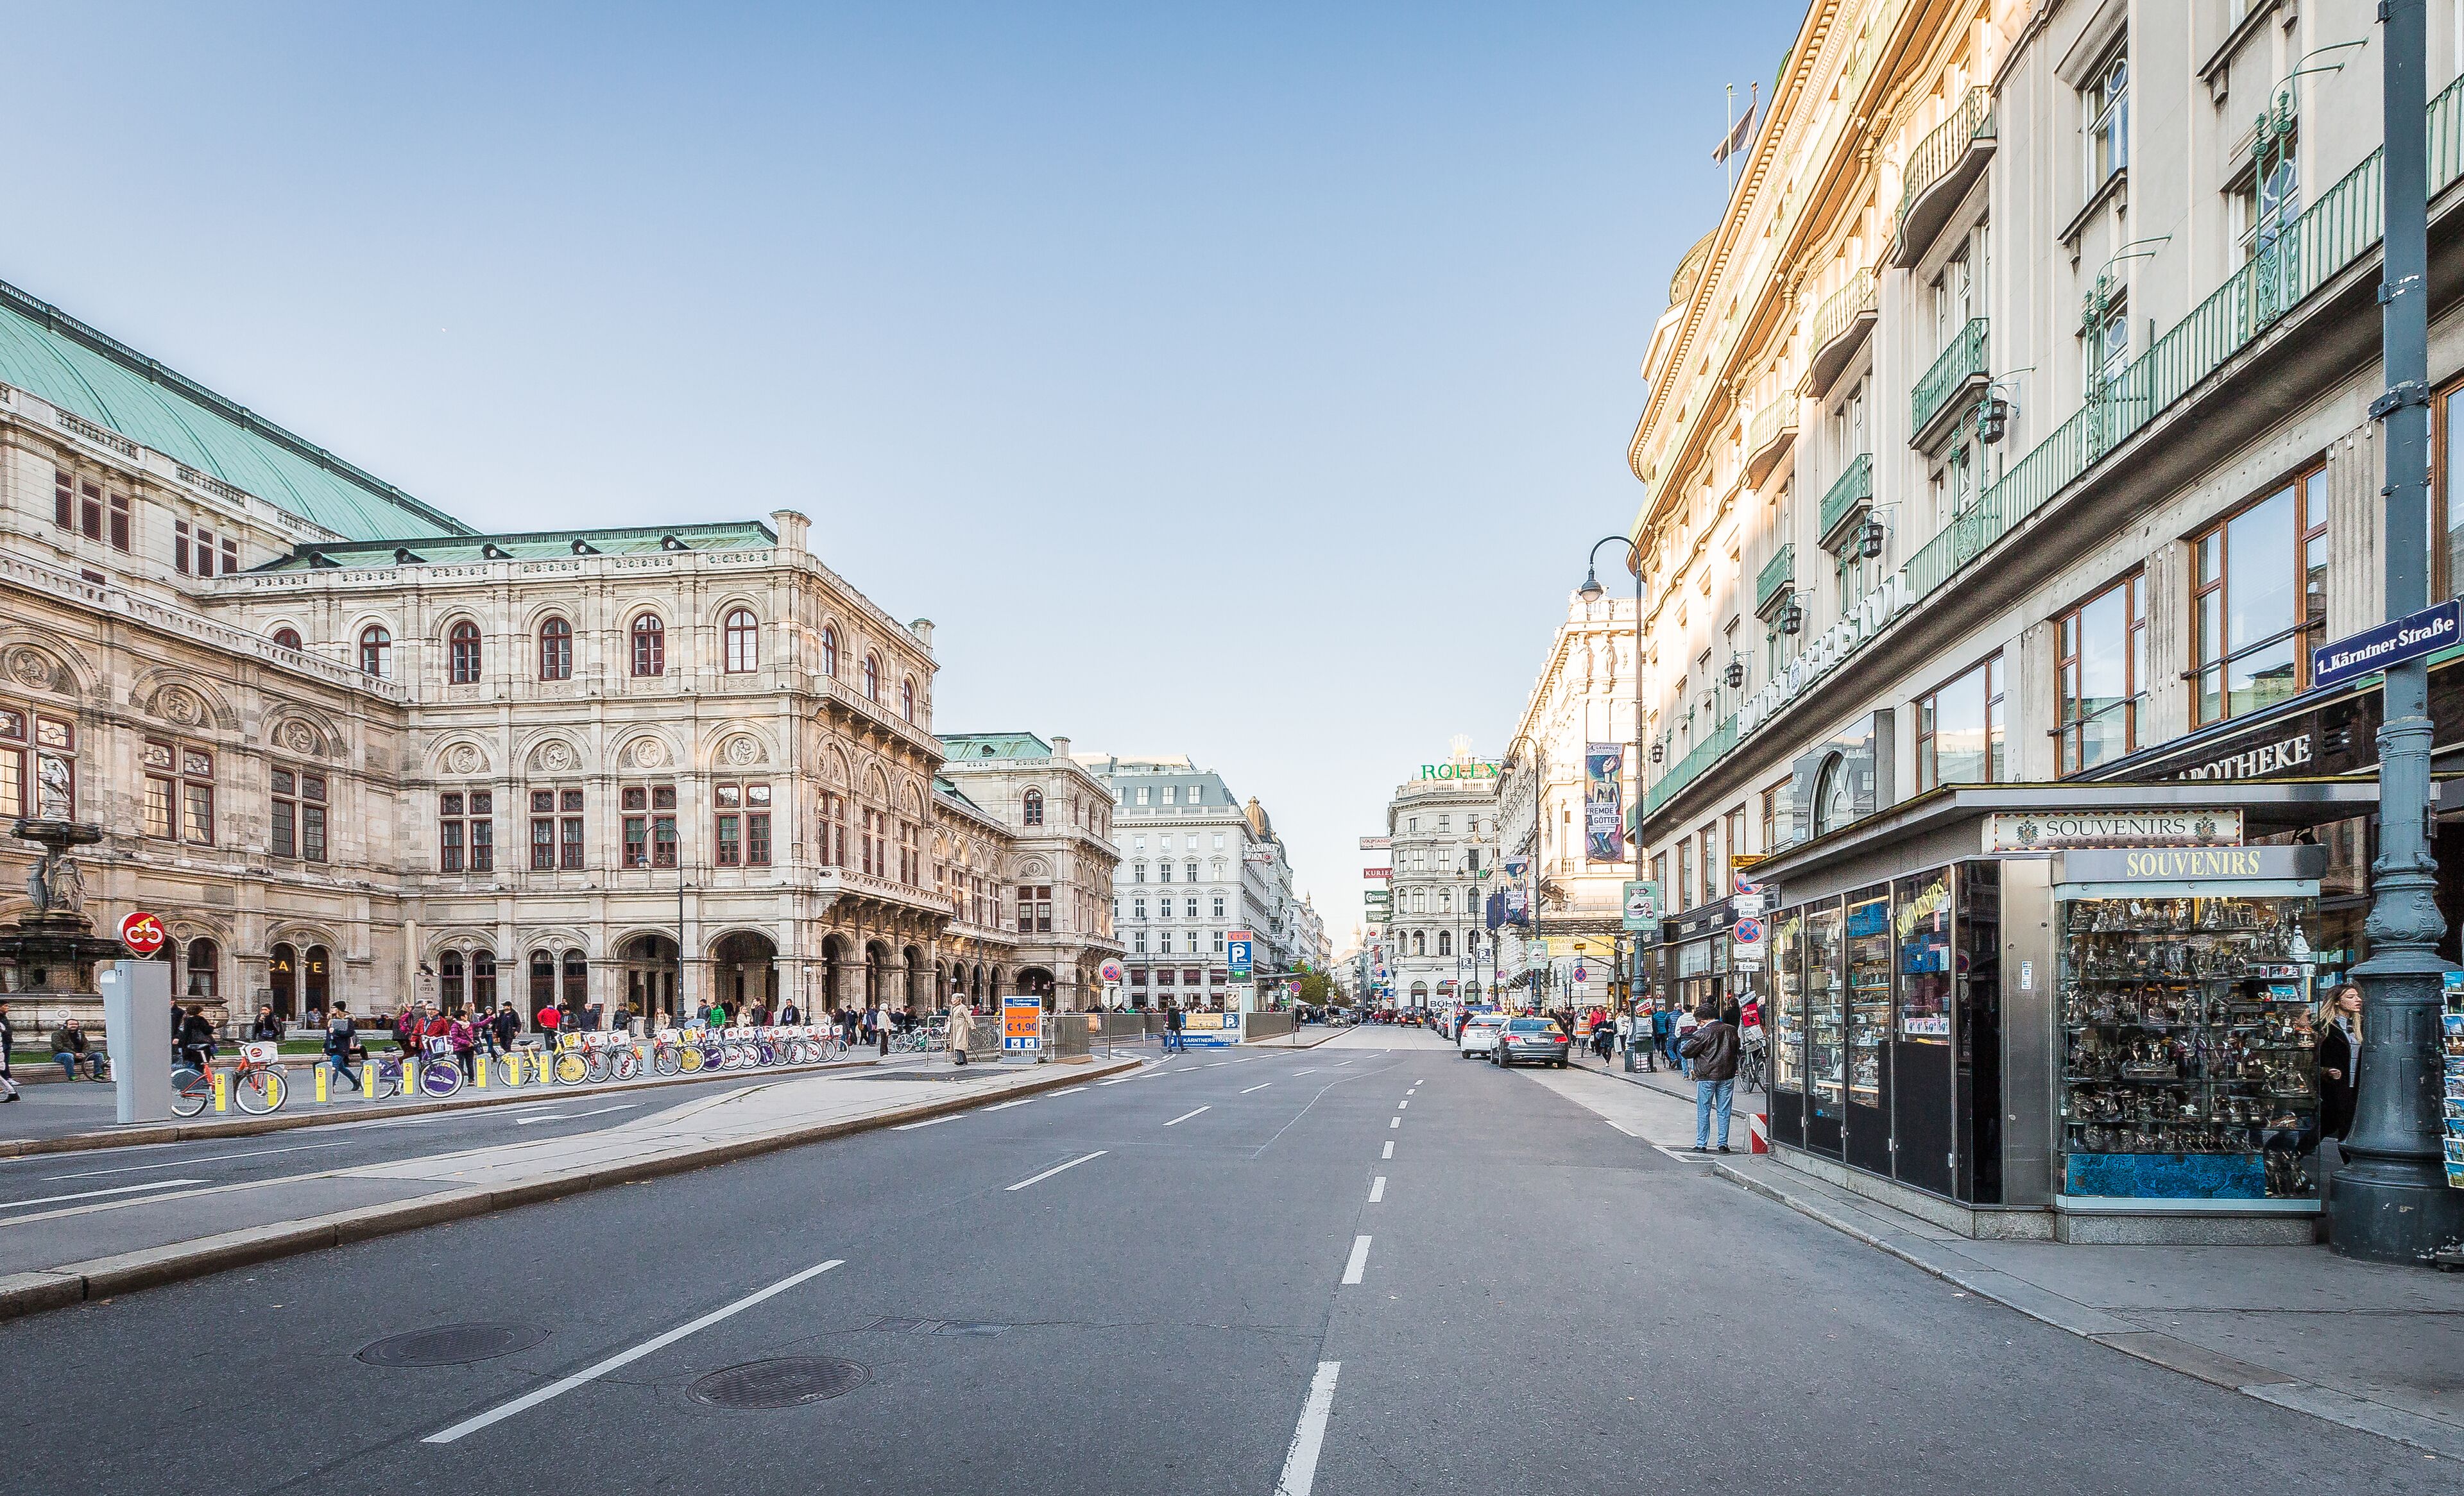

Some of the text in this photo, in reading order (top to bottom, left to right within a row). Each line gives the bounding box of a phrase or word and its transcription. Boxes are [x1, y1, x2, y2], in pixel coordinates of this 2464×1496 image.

[2331, 638, 2397, 669] Kärntner
[2399, 618, 2454, 647] Straße
[1421, 763, 1500, 779] ROLEX
[1594, 815, 1620, 824] GÖTTER
[2046, 818, 2187, 837] SOUVENIRS
[1245, 842, 1275, 852] CASINO
[2127, 850, 2261, 878] SOUVENIRS
[1365, 892, 1387, 903] Gösser
[1897, 878, 1945, 940] SOUVENIRS
[1016, 1023, 1037, 1032] 1,90
